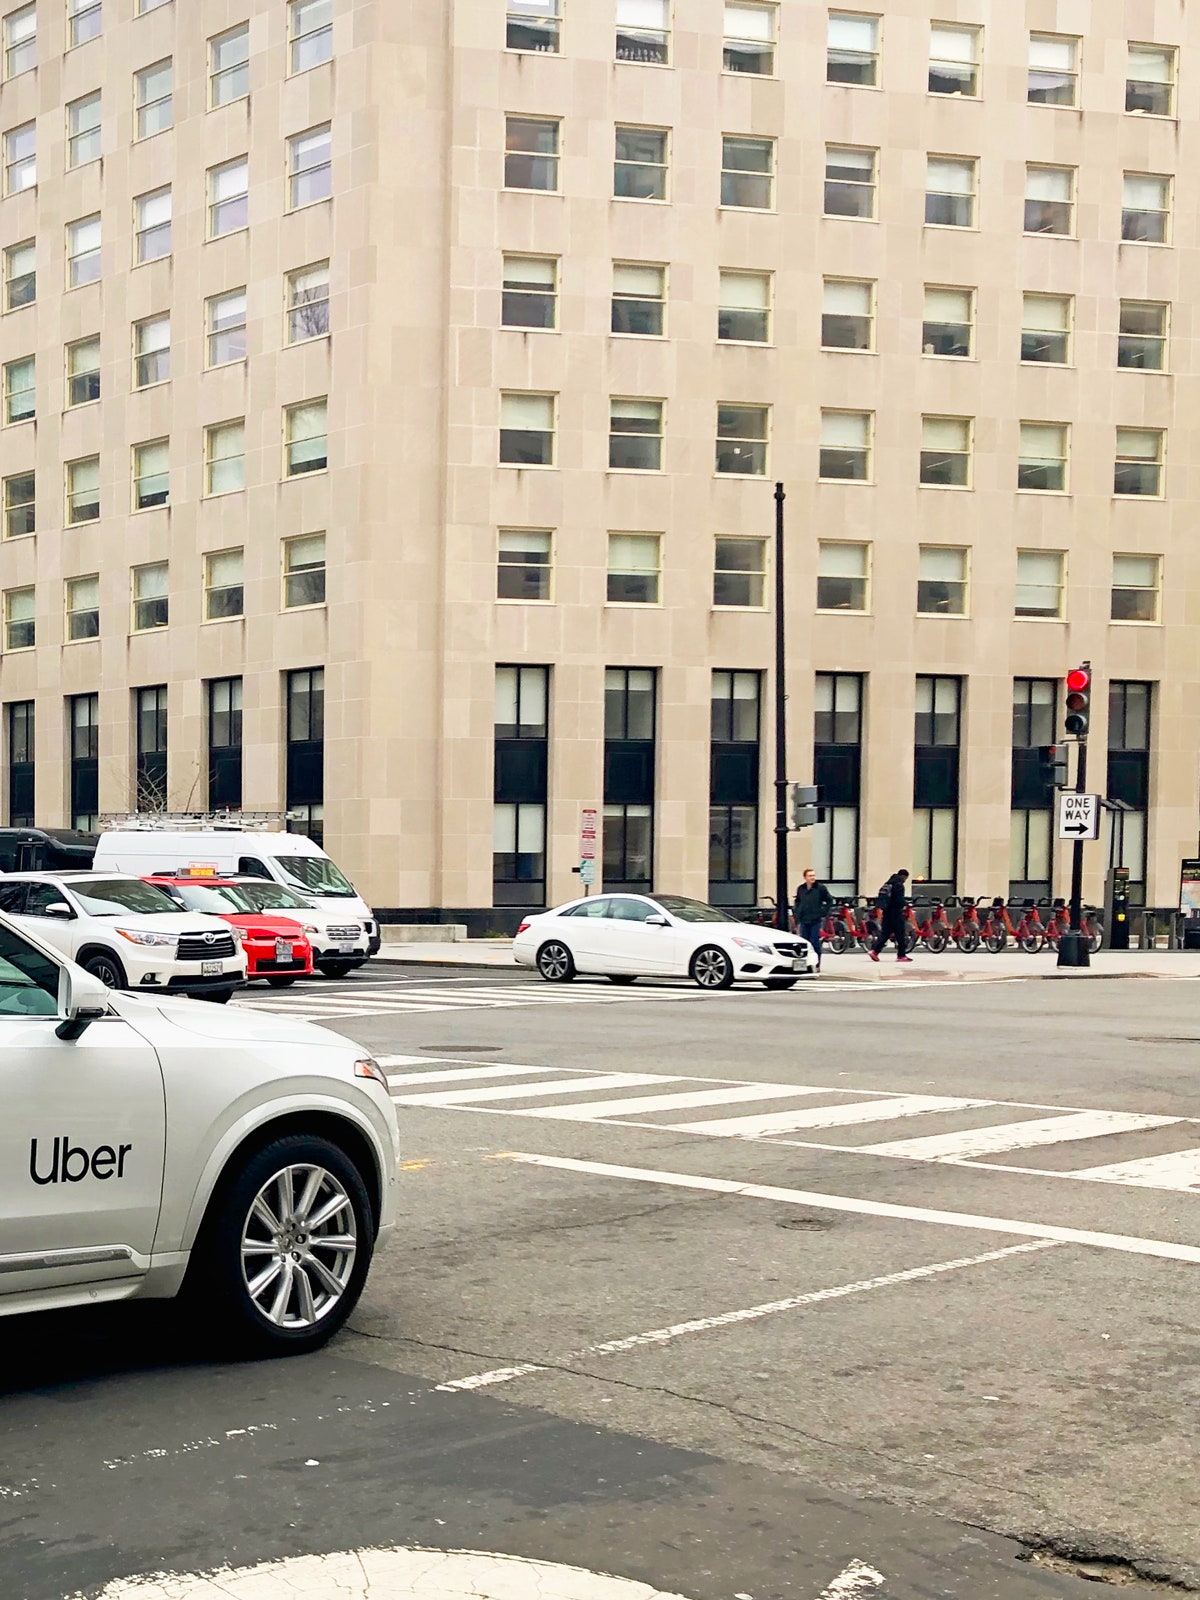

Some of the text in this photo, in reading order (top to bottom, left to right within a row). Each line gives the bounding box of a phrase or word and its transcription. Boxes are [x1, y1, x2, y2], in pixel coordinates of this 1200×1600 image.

[1066, 797, 1090, 808] ONE
[1065, 810, 1091, 820] WAY
[30, 1136, 132, 1185] Uber
